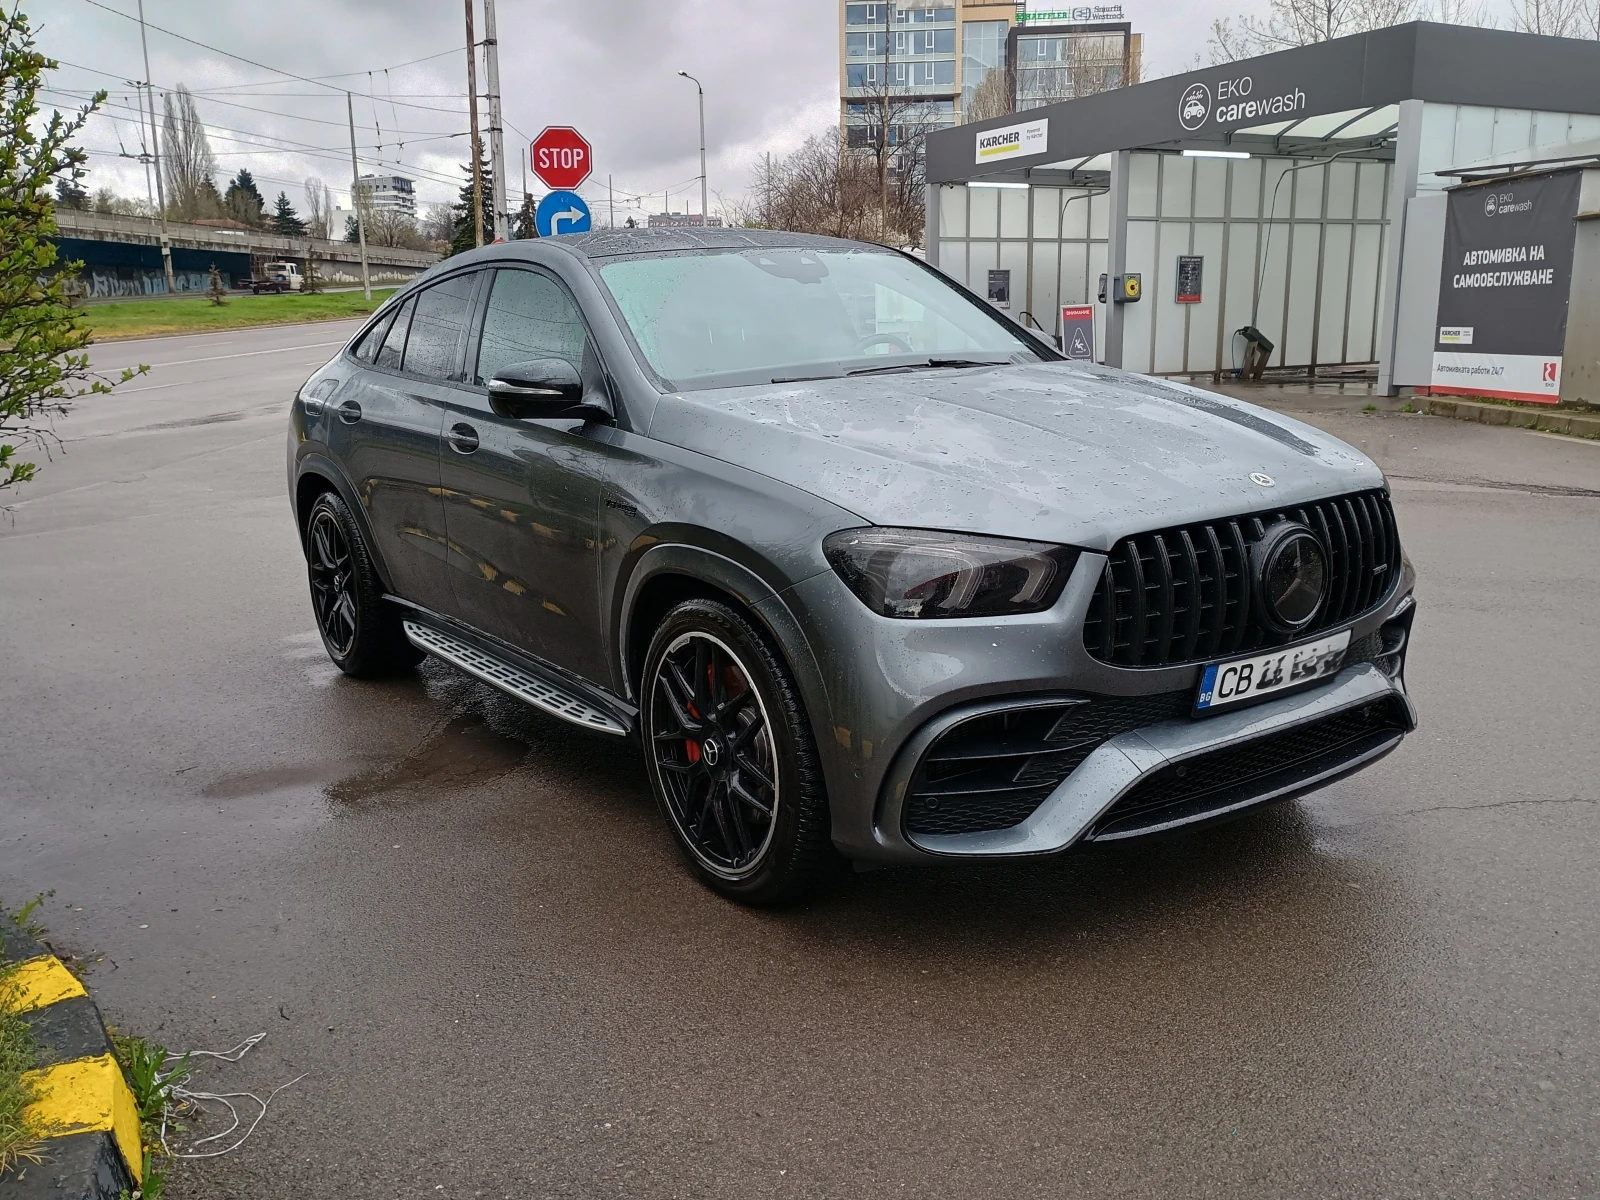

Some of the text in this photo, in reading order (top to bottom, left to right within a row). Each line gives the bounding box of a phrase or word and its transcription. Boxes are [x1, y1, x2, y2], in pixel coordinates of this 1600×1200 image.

[1217, 76, 1253, 100] EKO
[1216, 87, 1306, 122] carewash
[980, 131, 1020, 149] KÄRCHER
[539, 147, 584, 169] STOP
[1498, 200, 1533, 214] carewash
[1499, 193, 1514, 203] EKO
[1463, 244, 1545, 266] АВТОМИВКА НА
[1453, 268, 1554, 288] САМООБСЛУЖВАНЕ
[1436, 363, 1504, 376] Автомивката работи 24/7
[1200, 692, 1211, 702] BG
